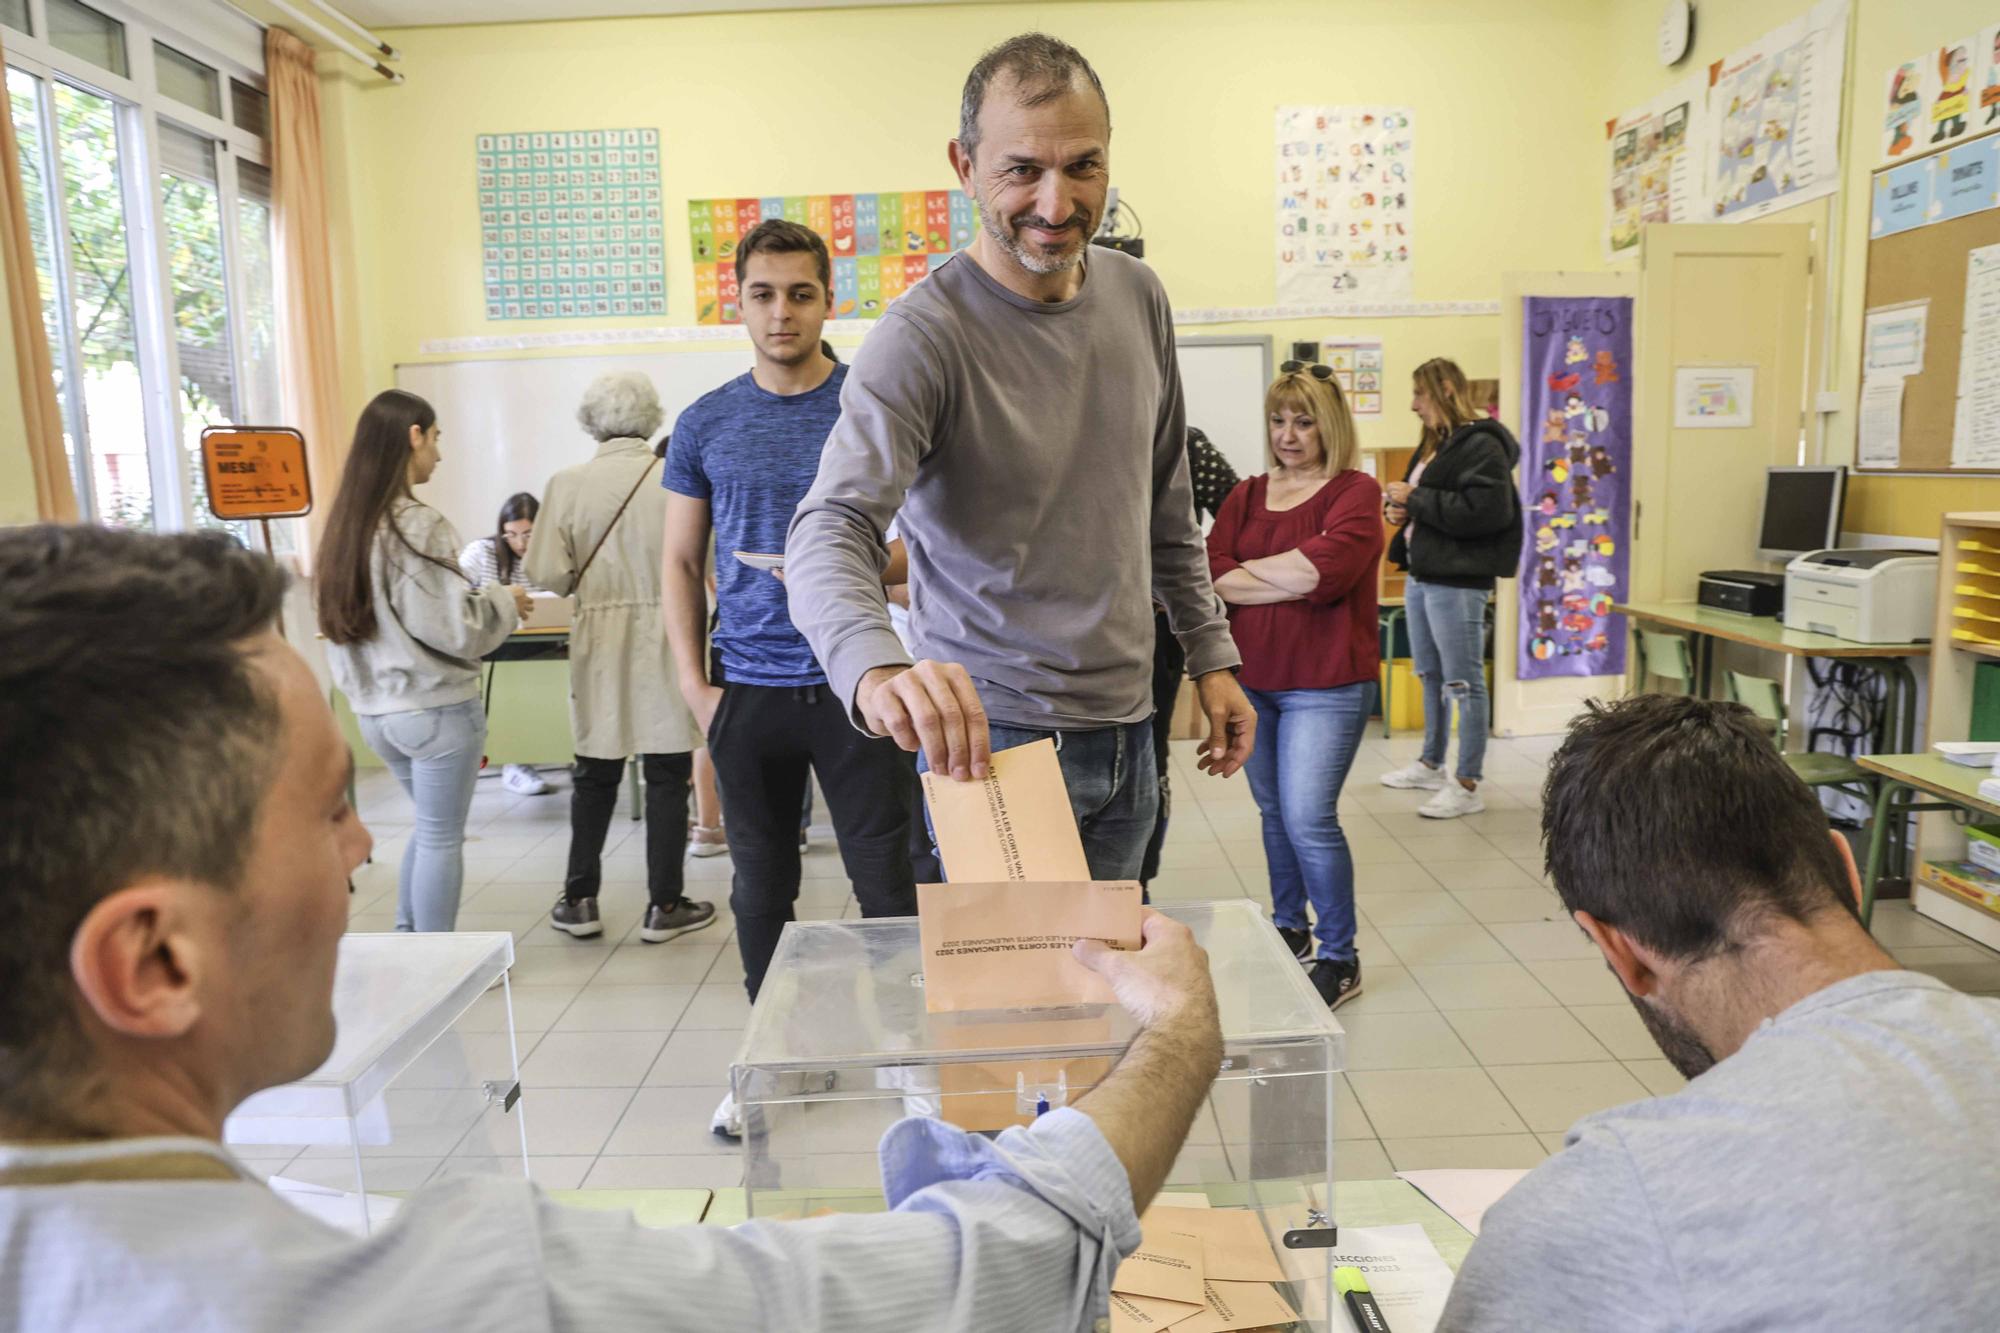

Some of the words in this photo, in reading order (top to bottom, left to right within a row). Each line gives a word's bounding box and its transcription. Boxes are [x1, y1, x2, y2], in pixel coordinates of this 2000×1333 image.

[218, 462, 256, 473] MESA
[987, 765, 1006, 810] ELECCIONS
[1001, 816, 1012, 833] LES
[999, 839, 1012, 863] CORTS
[1006, 833, 1020, 860] CORTS
[961, 937, 1015, 947] VALENCIANES
[957, 945, 1016, 955] VALENCIANES
[1373, 1264, 1401, 1273] 2023
